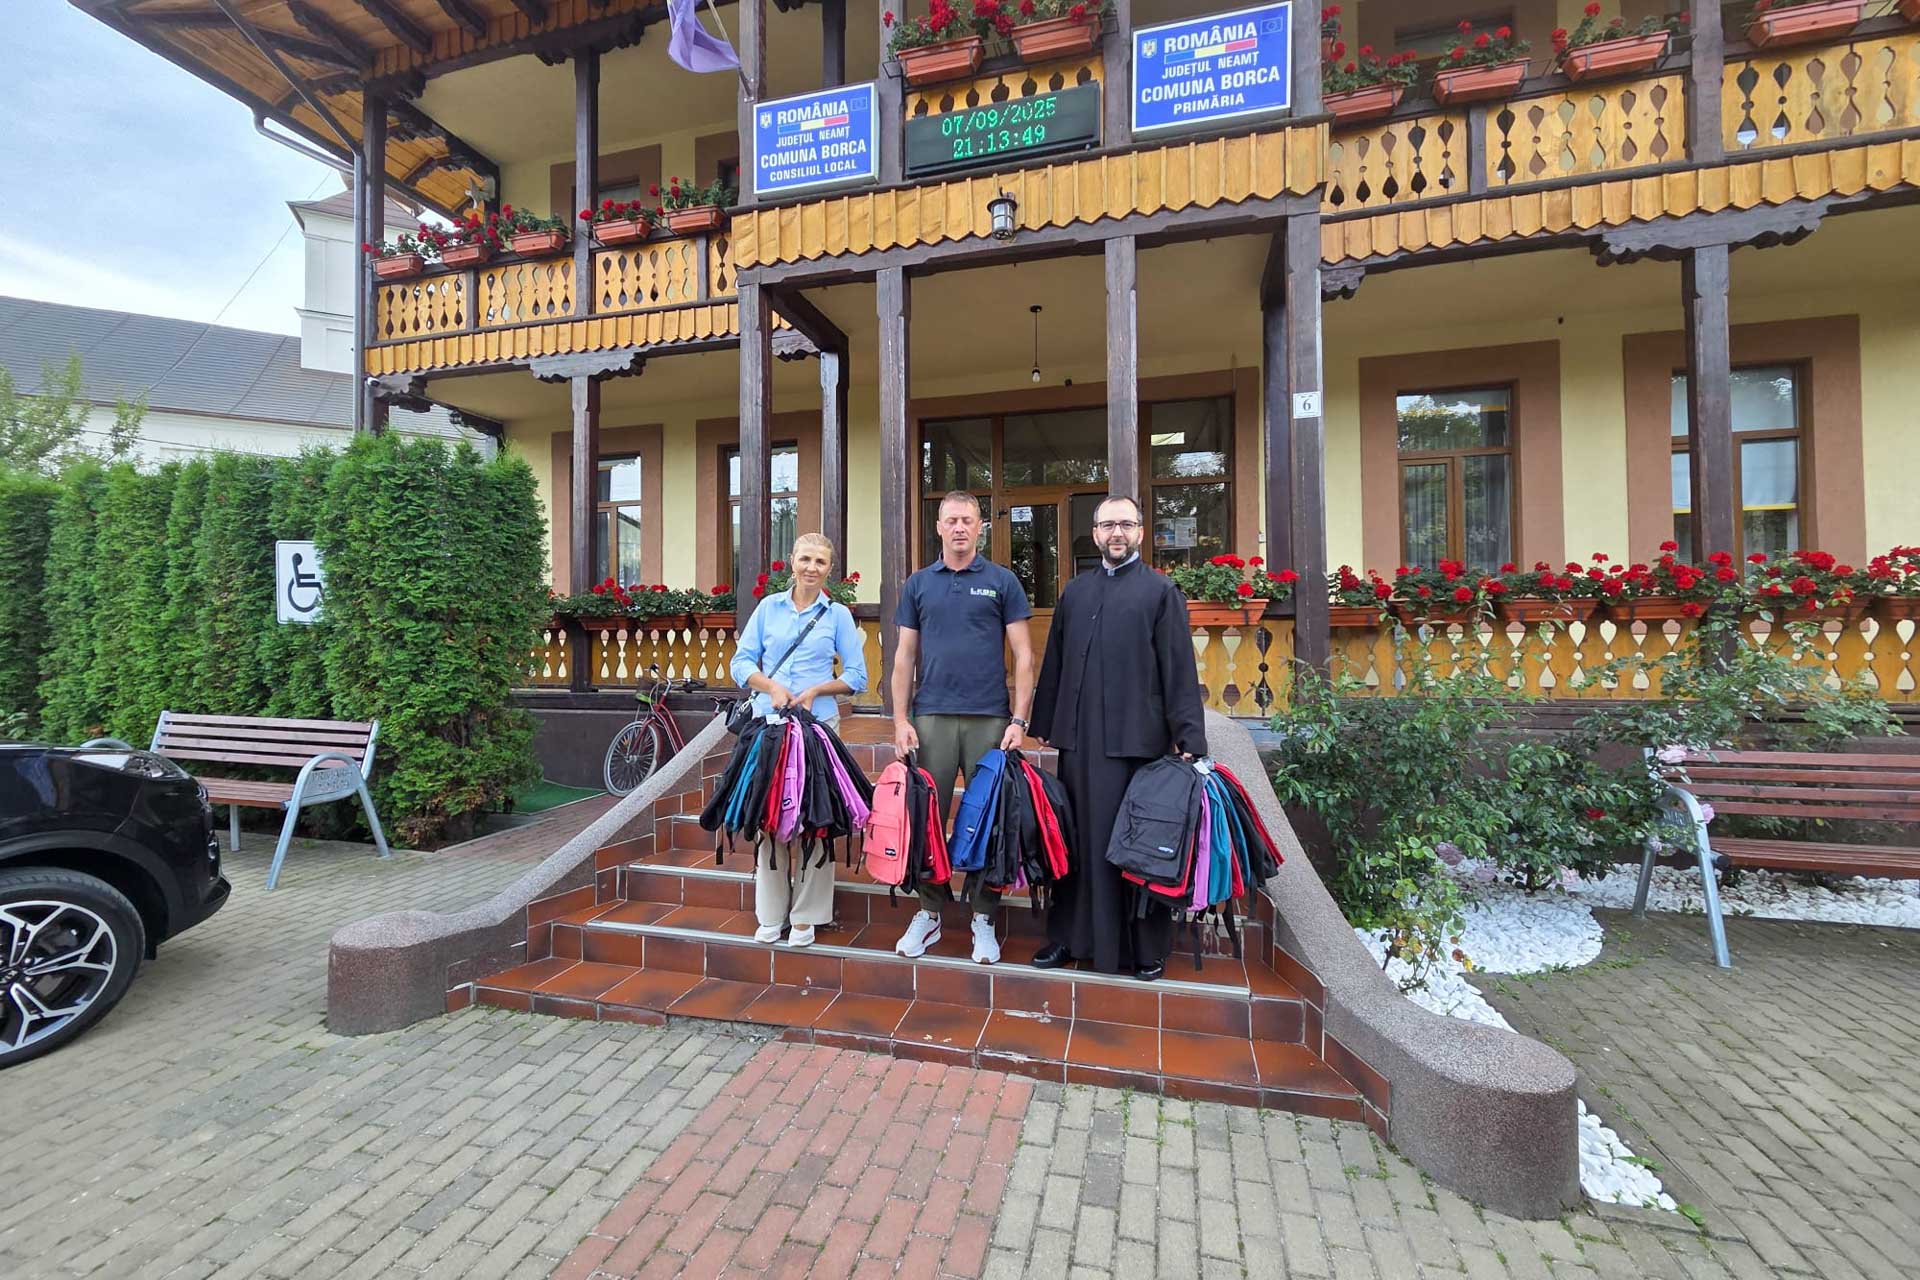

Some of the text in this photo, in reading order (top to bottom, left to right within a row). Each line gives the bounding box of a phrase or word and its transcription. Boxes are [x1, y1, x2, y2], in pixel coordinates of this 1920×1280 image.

[1164, 22, 1257, 53] ROMÂNIA
[1162, 51, 1259, 79] JUDEȚUL NEAMȚ
[1141, 66, 1280, 103] COMUNA BORCA
[777, 100, 848, 124] ROMÂNIA
[942, 97, 1057, 136] 07/09/2025
[1173, 93, 1245, 115] PRIMĂRIA
[776, 126, 850, 148] JUDEȚUL NEAMȚ
[953, 124, 1046, 159] 21:13:49
[761, 139, 866, 168] COMUNA BORCA
[770, 164, 821, 182] CONSILIUL
[825, 159, 857, 173] LOCAL
[1303, 398, 1311, 411] 6
